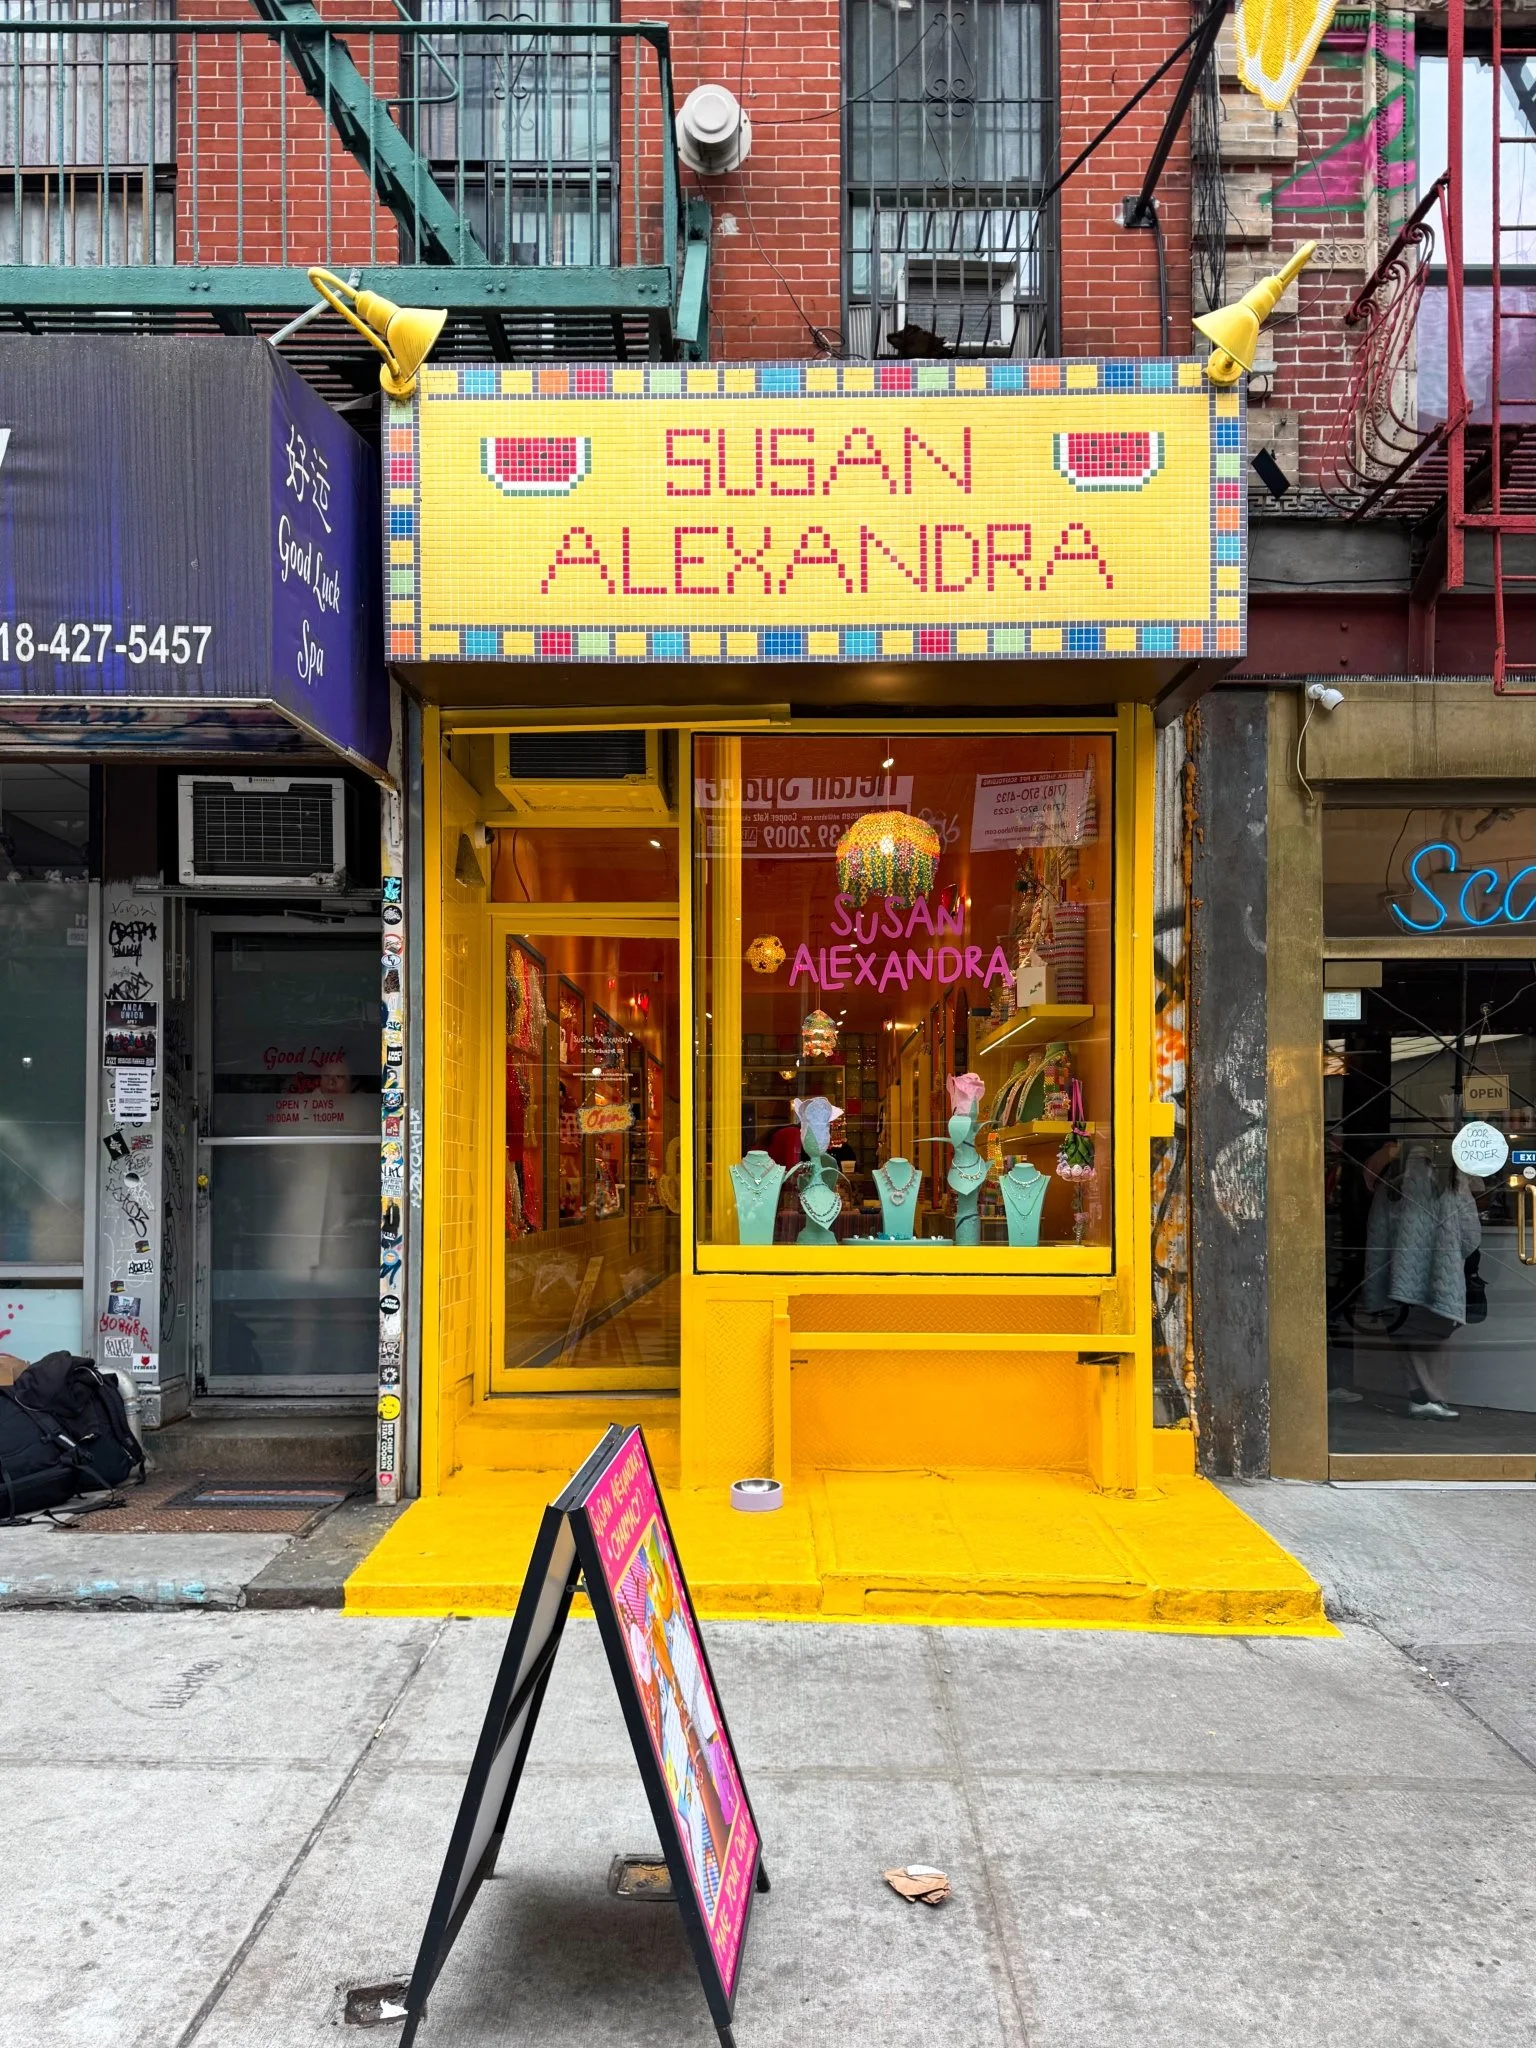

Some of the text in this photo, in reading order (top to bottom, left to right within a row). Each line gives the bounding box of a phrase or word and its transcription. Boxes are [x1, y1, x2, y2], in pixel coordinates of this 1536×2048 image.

[286, 423, 332, 534] 好运
[665, 426, 972, 497] SUSAN
[278, 514, 340, 619] Good Luck
[541, 523, 1114, 595] ALEXANDRA
[297, 619, 324, 685] Spa
[831, 893, 965, 944] SUSAN
[789, 944, 1018, 993] ALEXANDRA
[573, 1035, 594, 1044] SUSAN
[263, 1046, 346, 1070] Good Luck
[275, 1100, 334, 1109] OPEN 7 DAYS
[1469, 1088, 1503, 1099] OPEN
[1461, 1139, 1481, 1149] OUT
[1466, 1128, 1489, 1139] DOOR
[1461, 1149, 1500, 1162] ORDER
